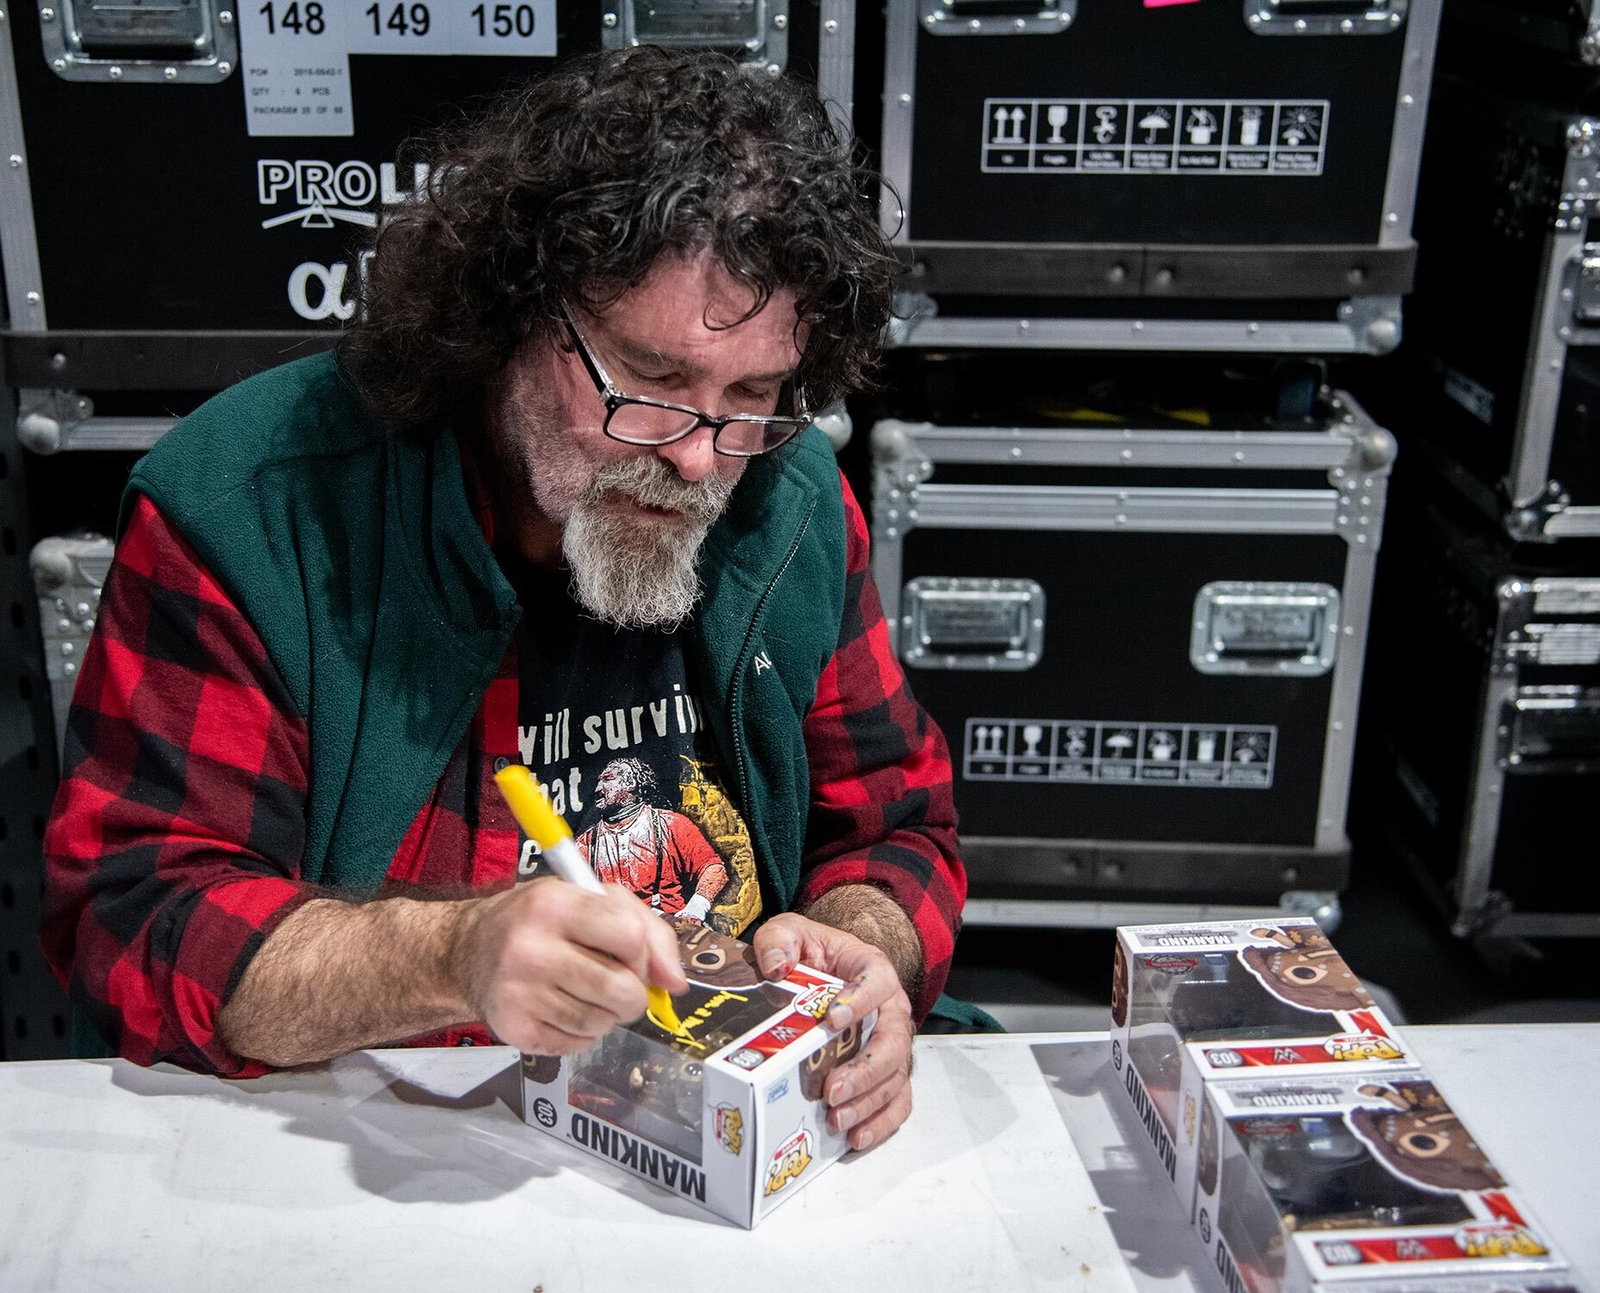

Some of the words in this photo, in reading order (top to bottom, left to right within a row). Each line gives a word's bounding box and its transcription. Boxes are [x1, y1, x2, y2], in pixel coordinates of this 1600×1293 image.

[260, 1, 325, 35] 148
[366, 3, 430, 36] 149
[471, 4, 534, 37] 150
[1157, 935, 1231, 947] MANKIND
[1211, 1050, 1240, 1065] 103
[1333, 1039, 1406, 1060] POP!
[537, 1099, 554, 1126] 103
[1253, 1093, 1336, 1107] MANKIND
[722, 1107, 743, 1156] POP!
[1126, 1063, 1177, 1184] MANKIND
[571, 1112, 706, 1203] MANKIND
[763, 1138, 813, 1197] POP!
